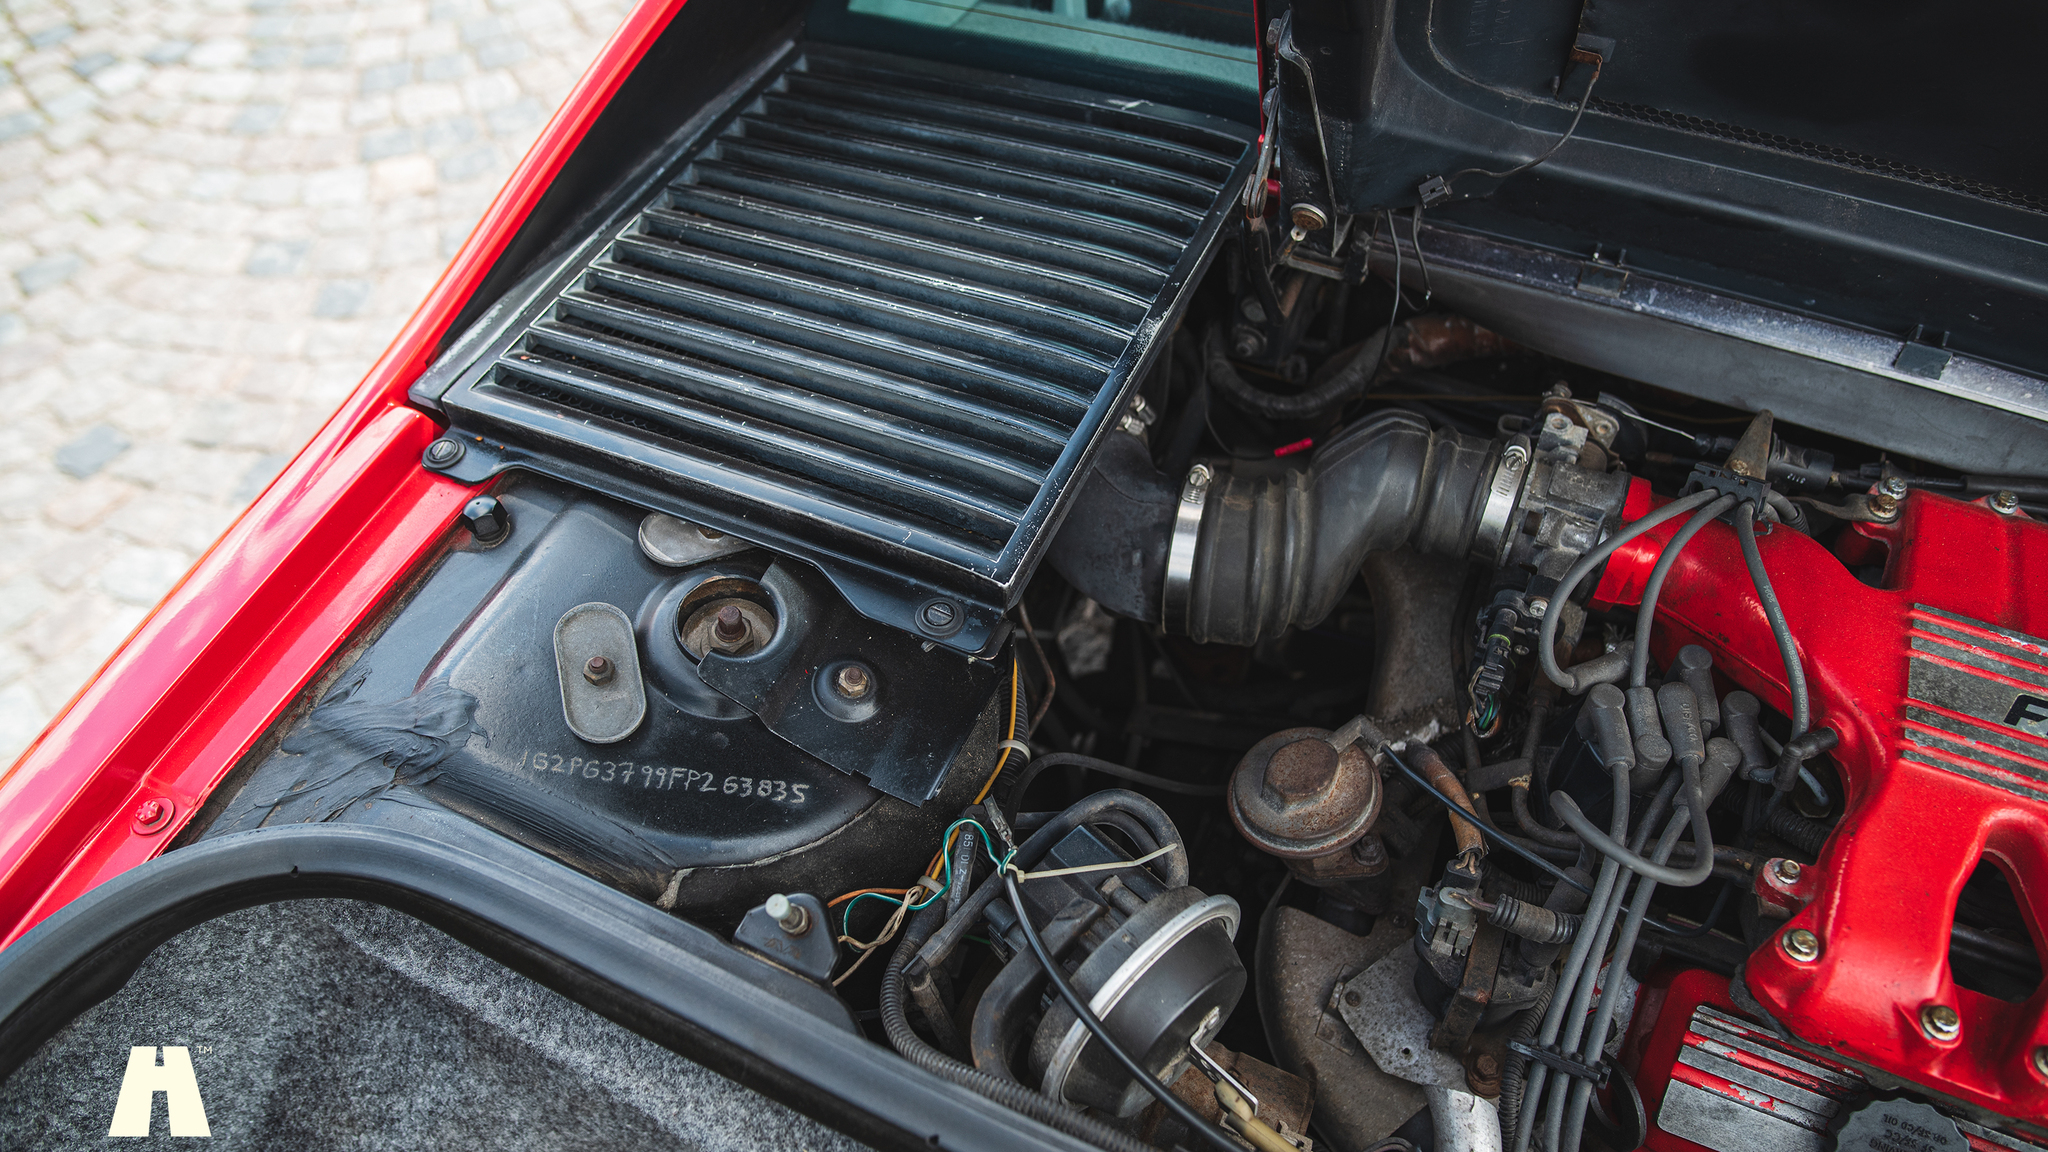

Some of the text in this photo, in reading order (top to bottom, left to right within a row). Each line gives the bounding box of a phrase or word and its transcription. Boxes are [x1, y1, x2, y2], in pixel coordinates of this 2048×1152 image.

[1782, 631, 1804, 685] SUPPRESSION
[1798, 687, 1808, 723] SILICONE
[1883, 1113, 1899, 1126] OIL
